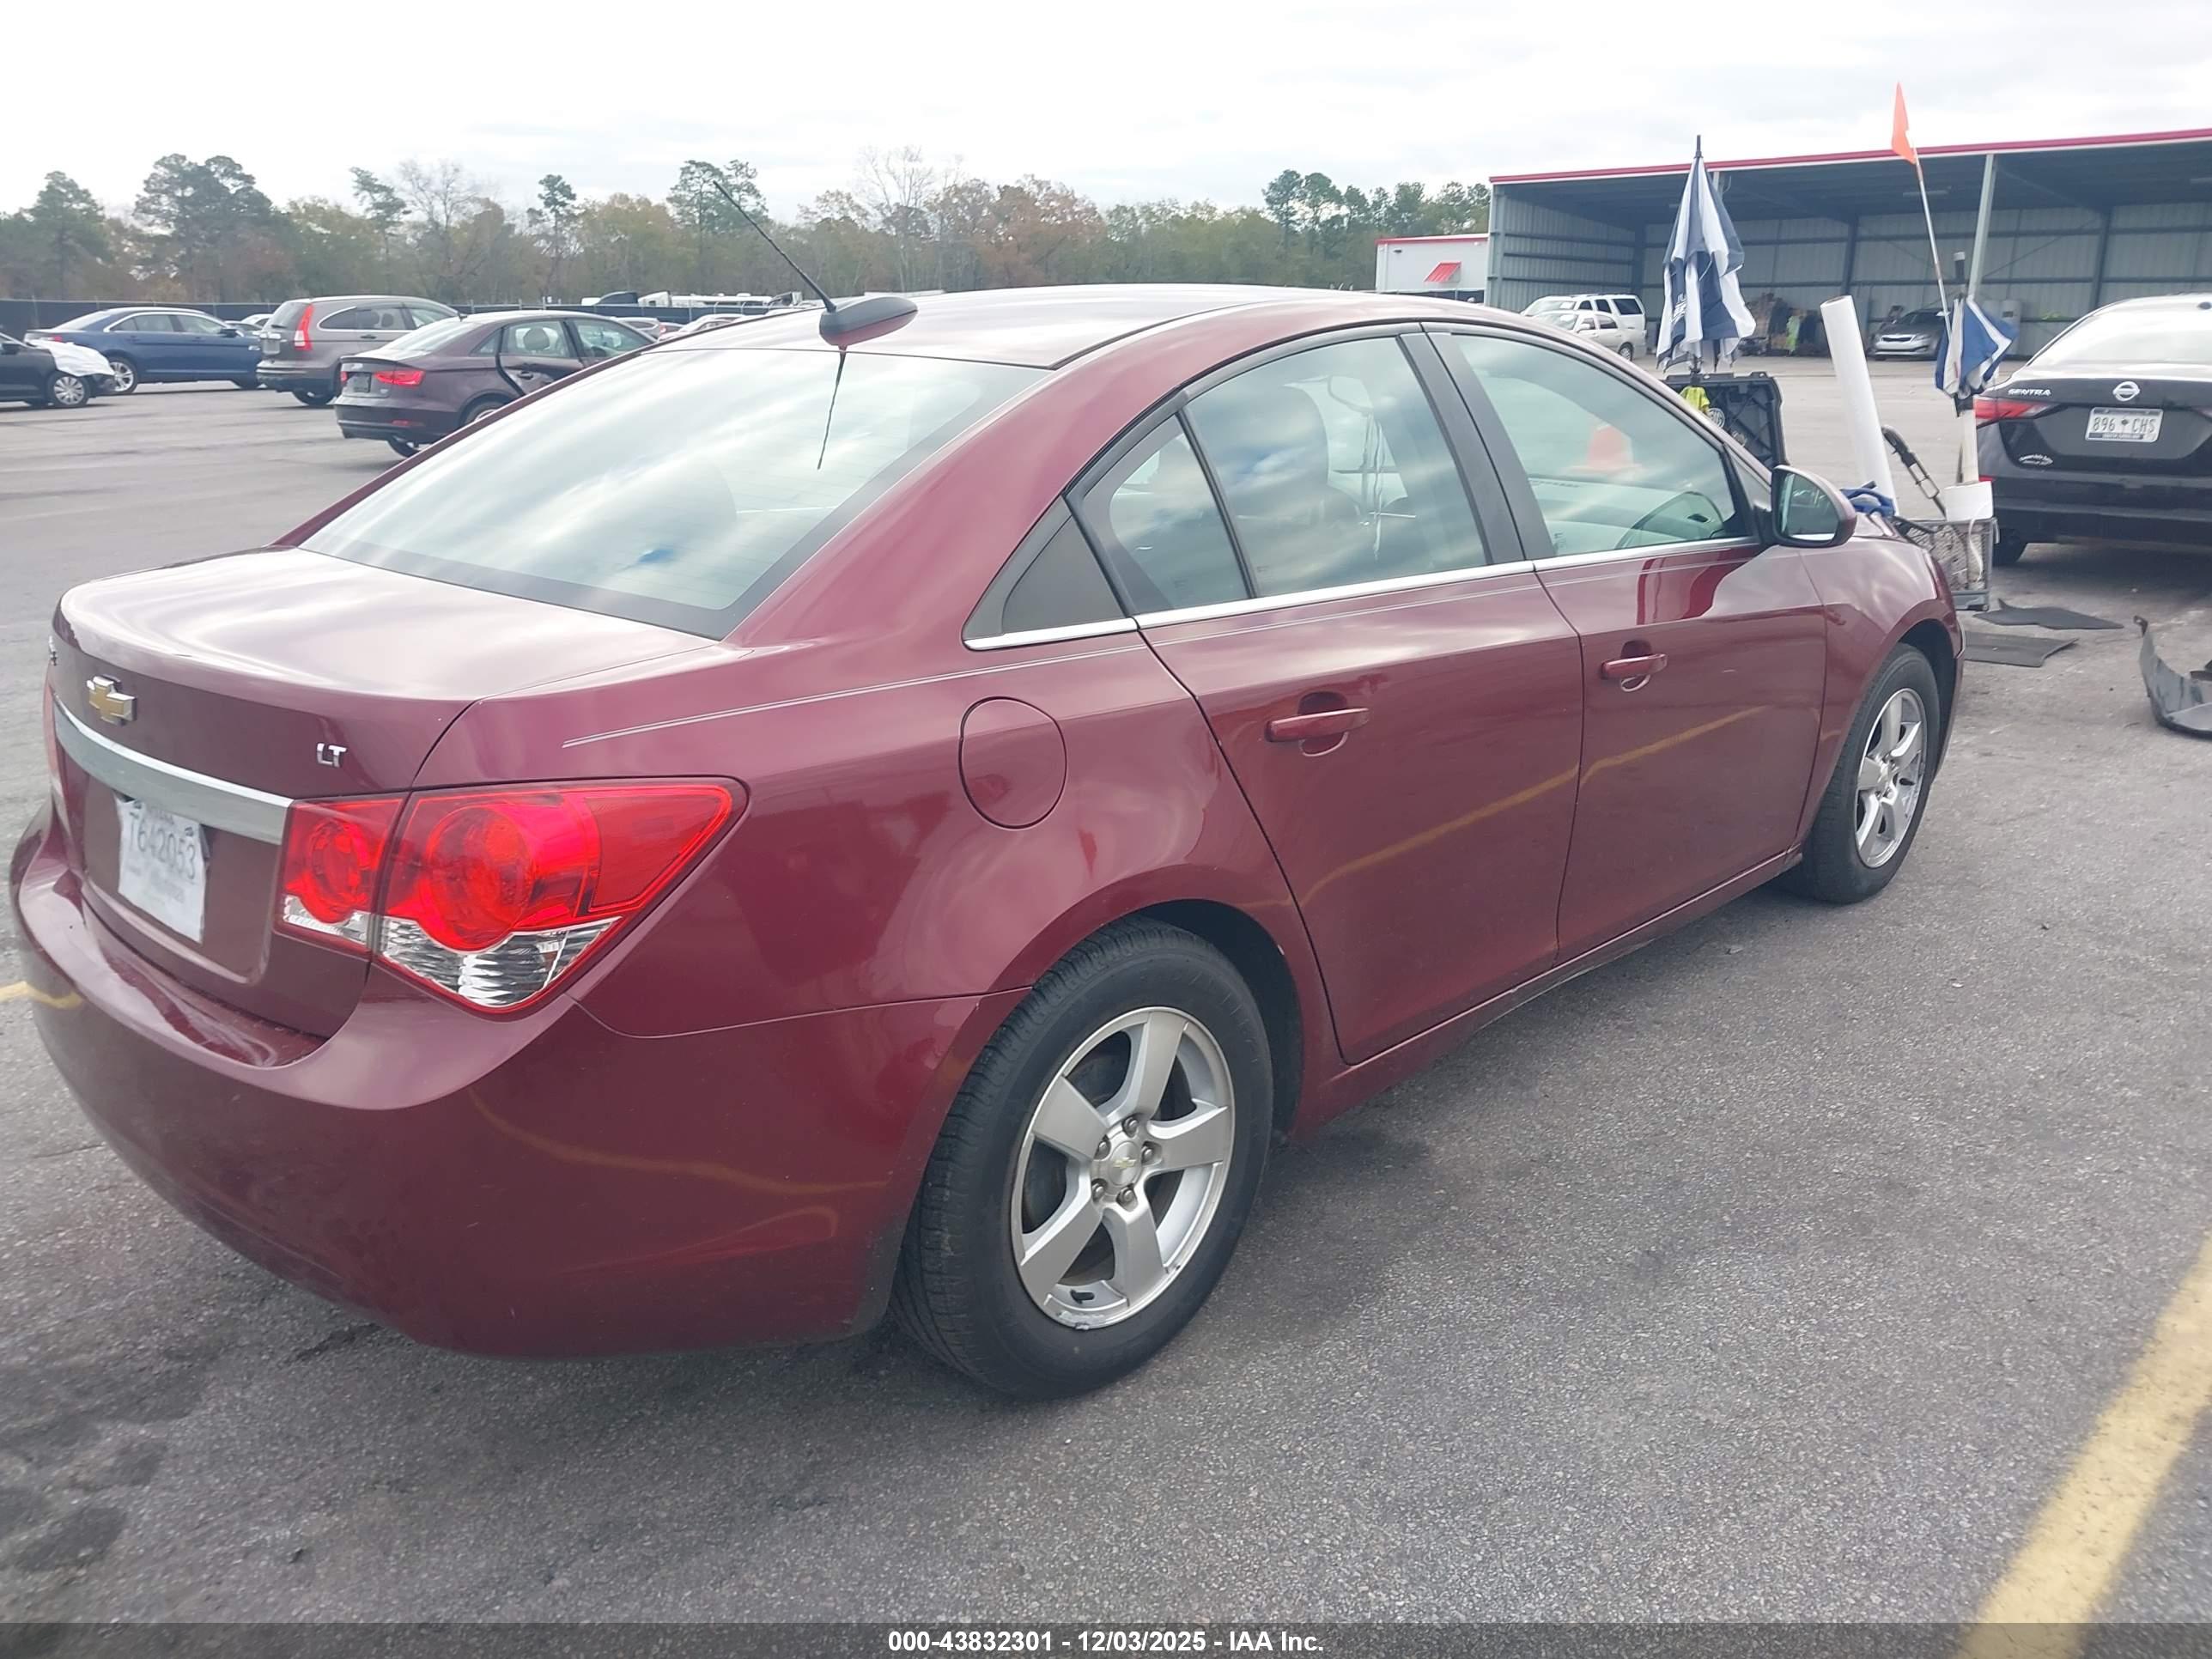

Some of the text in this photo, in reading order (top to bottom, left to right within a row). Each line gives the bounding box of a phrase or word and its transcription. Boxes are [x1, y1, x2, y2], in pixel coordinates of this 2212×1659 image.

[2008, 388, 2051, 397] SENTRA
[2093, 416, 2156, 433] 896 CHS
[317, 743, 347, 768] LT
